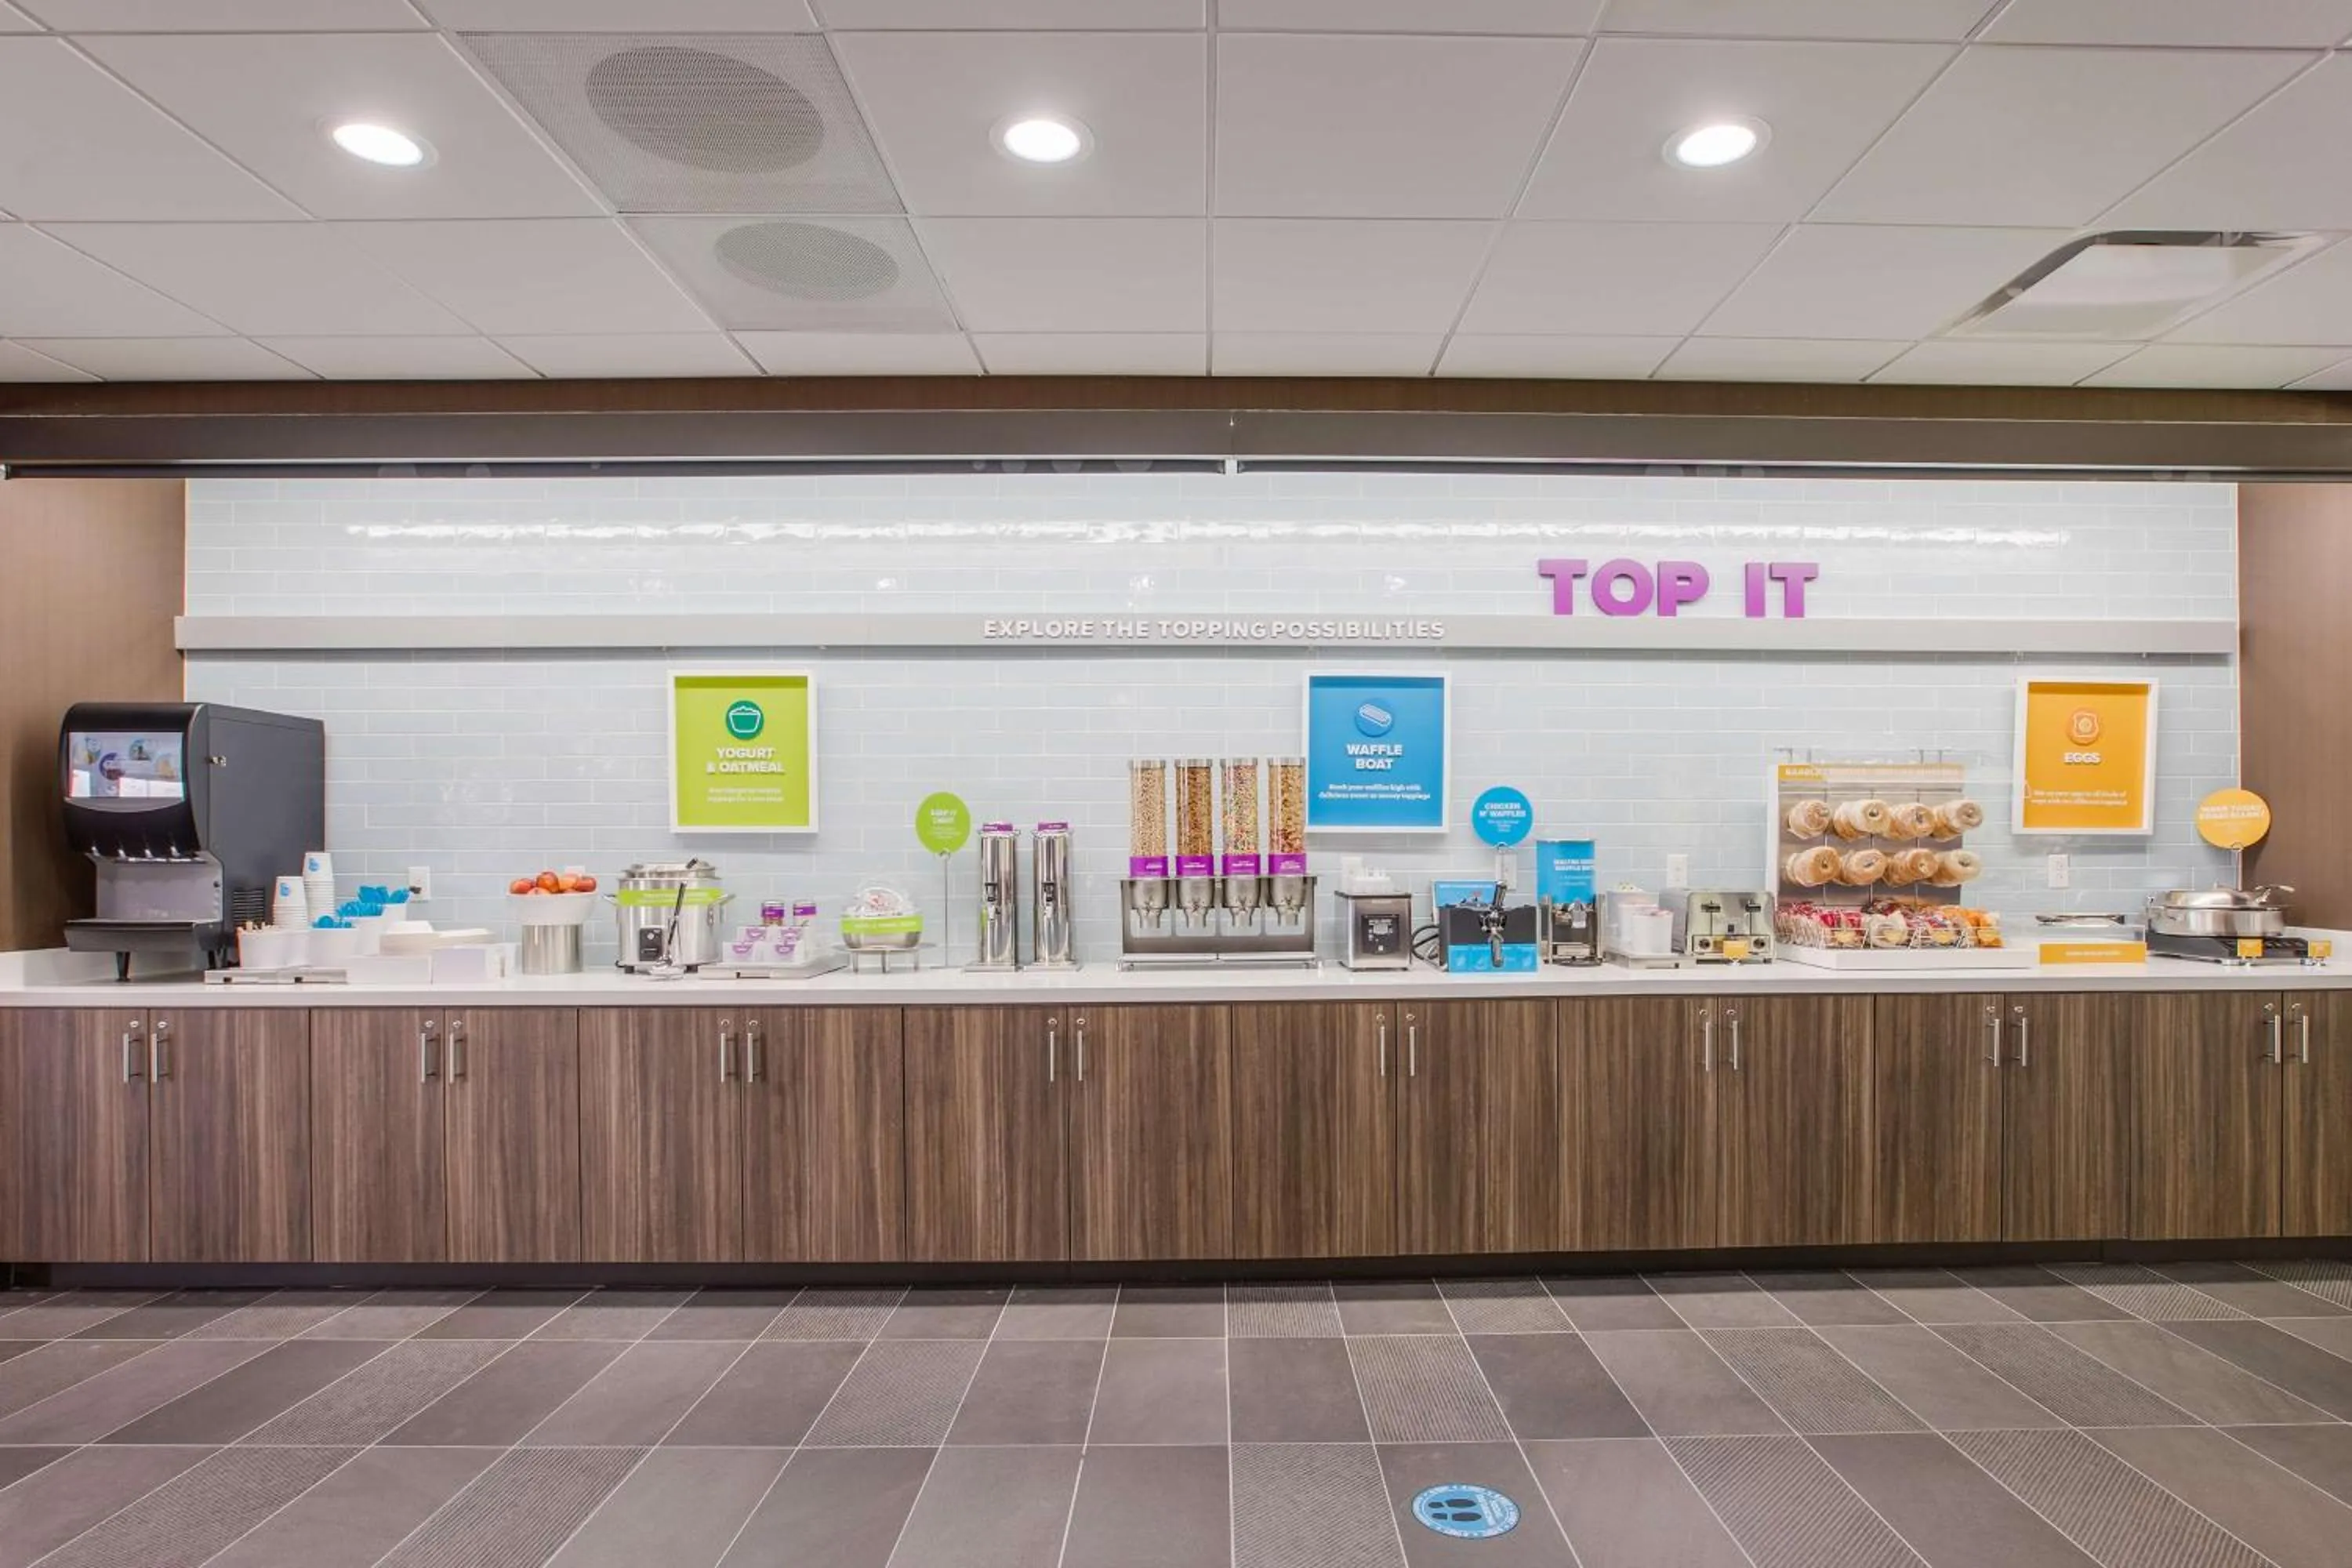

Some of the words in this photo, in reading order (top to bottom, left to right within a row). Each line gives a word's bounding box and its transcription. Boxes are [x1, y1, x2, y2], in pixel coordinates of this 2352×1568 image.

[1538, 558, 1710, 617] TOP
[1744, 562, 1819, 618] IT
[984, 620, 1094, 638] EXPLORE
[1102, 620, 1149, 638] THE
[1158, 620, 1266, 639] TOPPING
[1271, 621, 1445, 640] POSSIBILITIES
[717, 747, 776, 759] YOGURT
[1346, 744, 1403, 756] WAFFLE
[1355, 758, 1394, 770] BOAT
[2063, 752, 2101, 764] EGGS
[719, 760, 786, 773] OATMEAL
